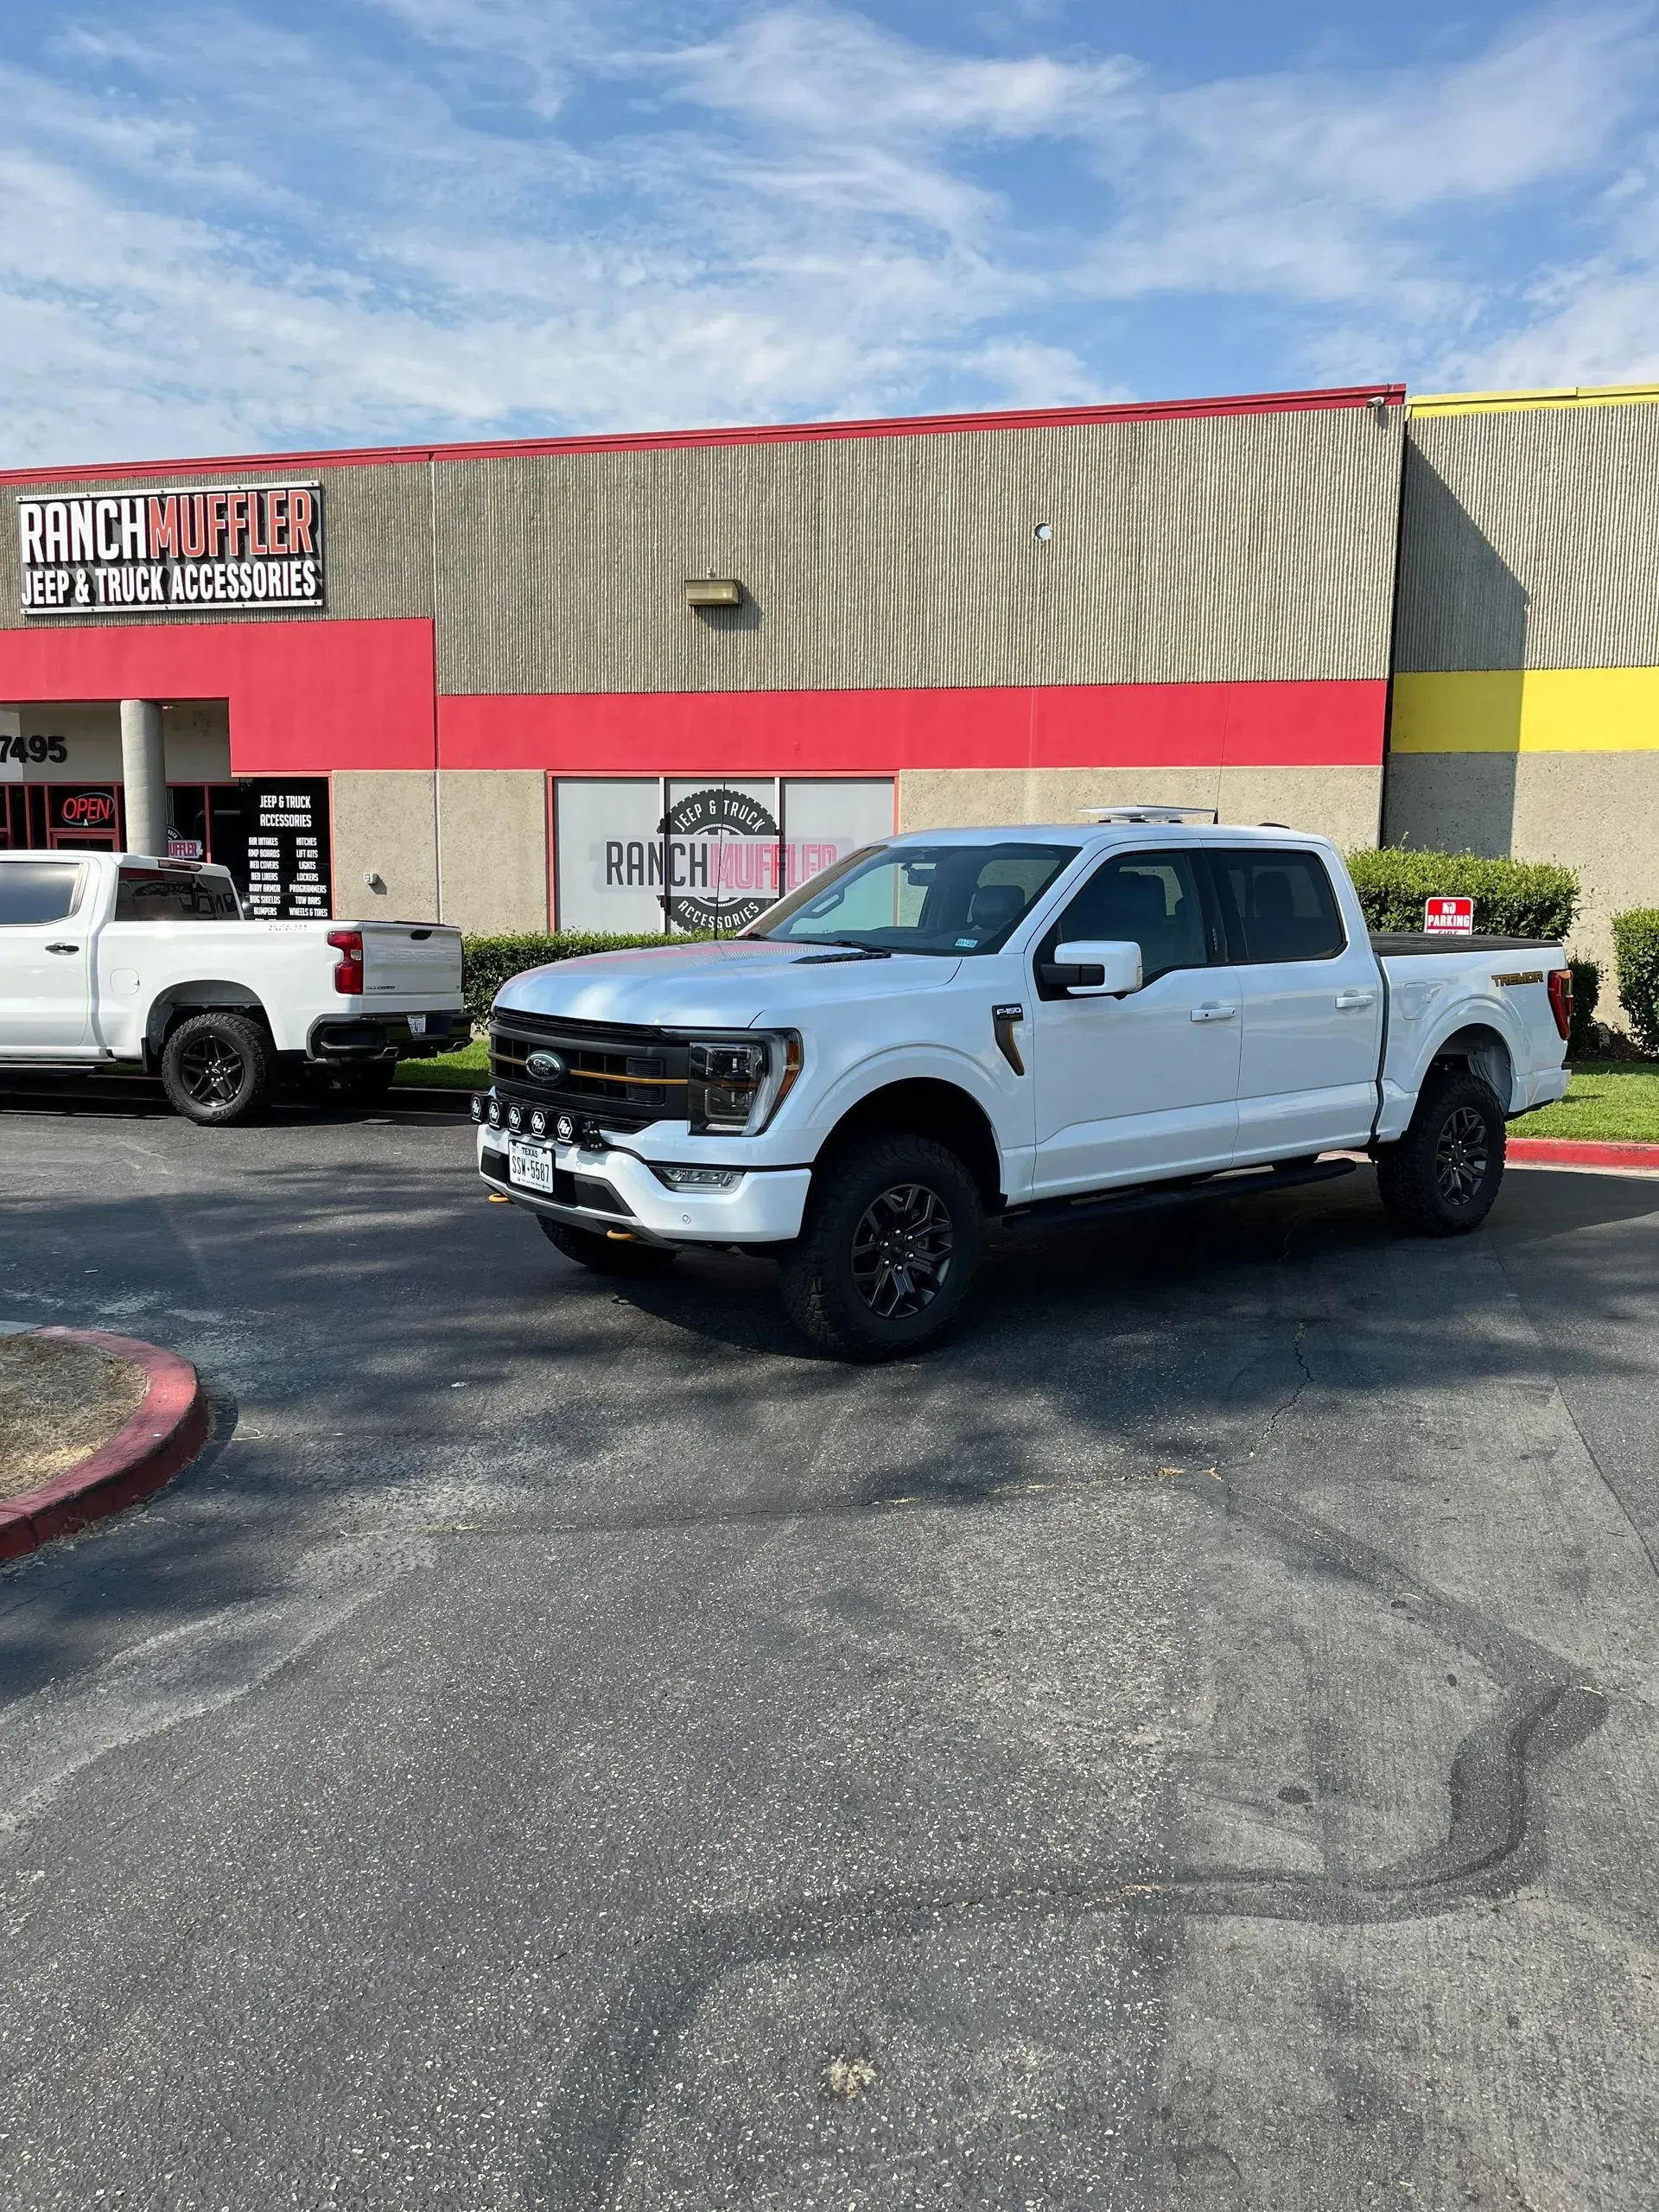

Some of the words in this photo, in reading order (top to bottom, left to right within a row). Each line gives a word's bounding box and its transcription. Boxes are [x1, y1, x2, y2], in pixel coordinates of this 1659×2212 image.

[22, 569, 69, 606] JEEP
[74, 569, 91, 604] &
[95, 566, 165, 603] TRUCK
[172, 560, 316, 601] ACCESSORIES
[0, 734, 67, 763] 7495
[259, 795, 277, 809] JEEP
[278, 795, 285, 809] &
[285, 795, 312, 809] TRUCK
[63, 798, 111, 819] OPEN
[259, 814, 312, 827] ACCESSORIES
[674, 803, 703, 833] JEEP
[709, 799, 717, 815] &
[723, 799, 766, 834] TRUCK
[248, 836, 257, 846] AIR
[257, 836, 279, 846] INTAKES
[296, 836, 317, 846] HITCHES
[168, 842, 197, 857] UFFLER
[247, 849, 259, 857] AMP
[259, 849, 281, 858] BOARDS
[296, 849, 307, 858] LIFT
[307, 849, 319, 859] KITS
[249, 860, 259, 869] BED
[259, 861, 280, 869] COVERS
[298, 861, 316, 870] LIGHTS
[251, 872, 261, 880] BED
[261, 872, 279, 881] LINERS
[296, 872, 319, 881] LOCKERS
[249, 883, 263, 893] BODY
[262, 884, 282, 893] ARMOR
[289, 884, 327, 893] PROGRAMMERS
[249, 895, 260, 904] BUG
[260, 896, 281, 905] SHIELDS
[295, 895, 307, 905] TOW
[307, 896, 321, 906] BARS
[253, 907, 277, 916] BUMPERS
[289, 907, 309, 917] WHEELS
[308, 907, 314, 917] &
[314, 908, 328, 918] TIRES
[1442, 901, 1457, 915] NO
[677, 899, 760, 929] ACCESSORIES
[1427, 914, 1471, 927] PARKING
[1491, 971, 1544, 987] TREMOR
[996, 1007, 1022, 1015] F-150
[521, 1147, 538, 1158] TEXAS
